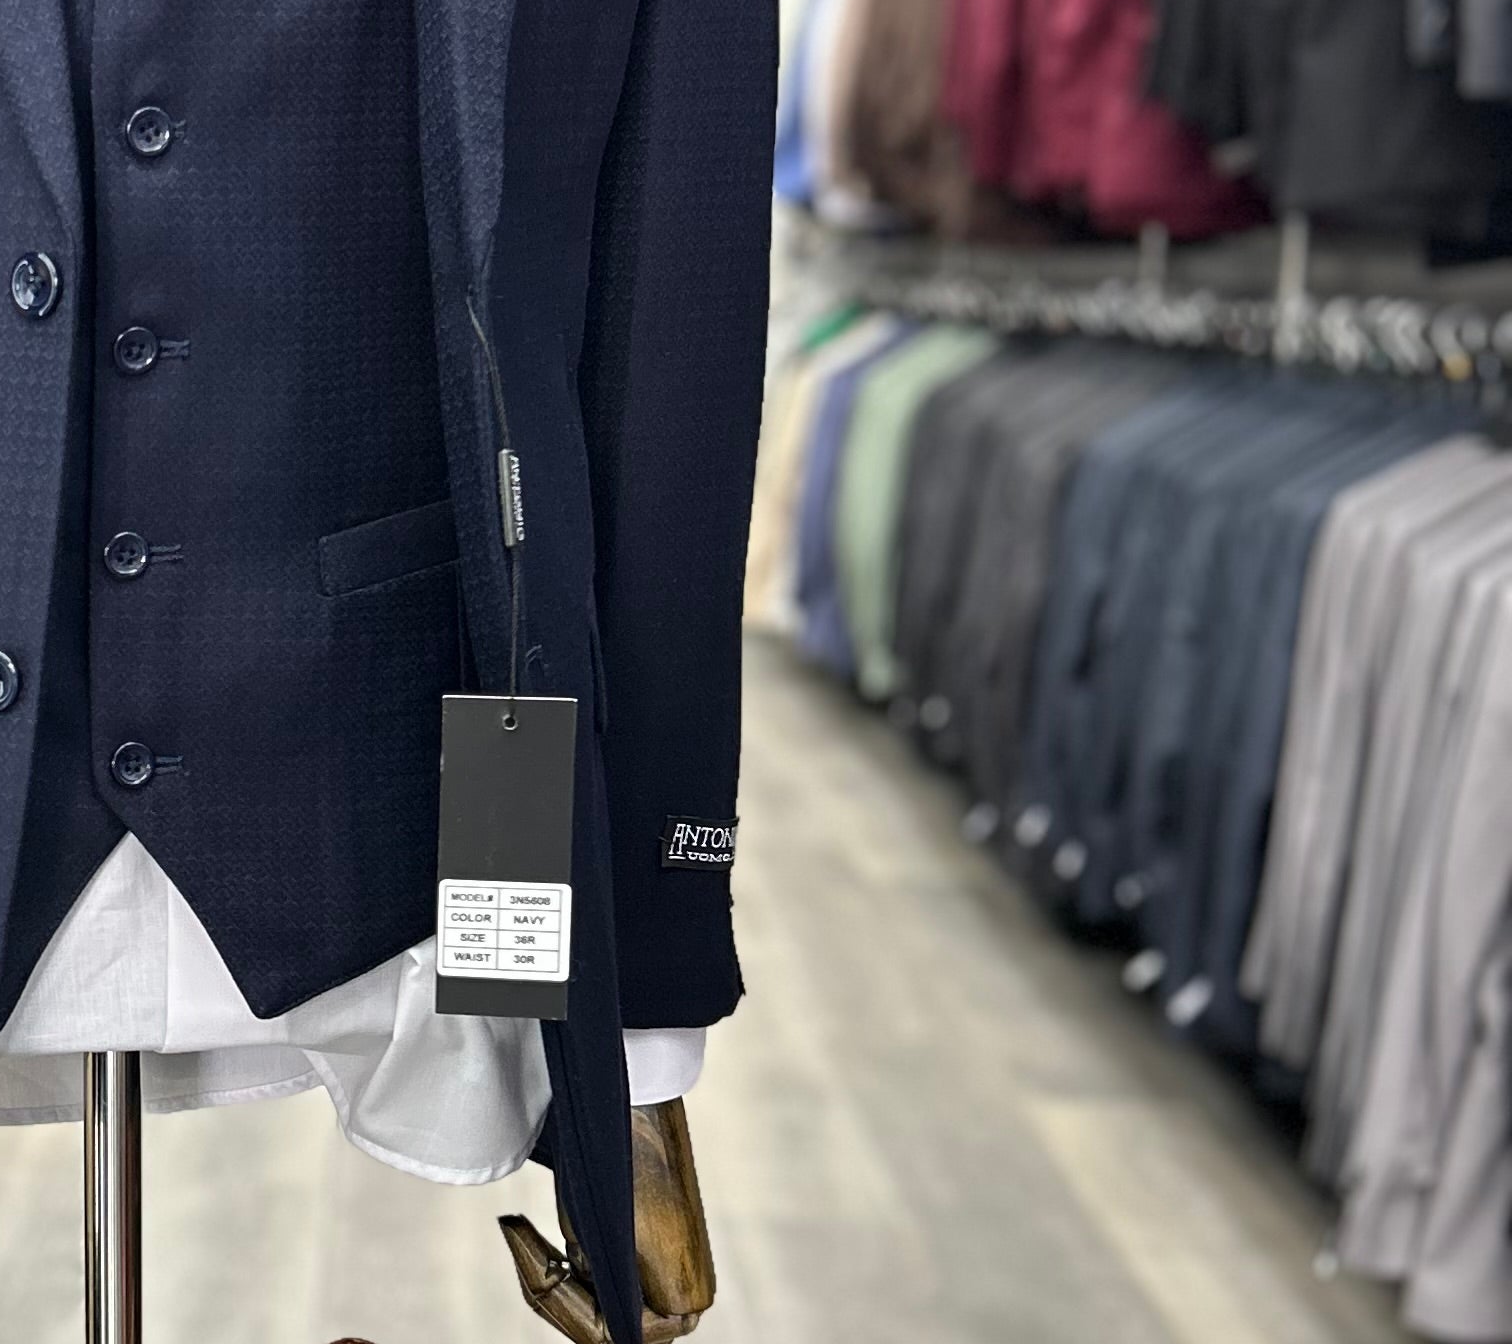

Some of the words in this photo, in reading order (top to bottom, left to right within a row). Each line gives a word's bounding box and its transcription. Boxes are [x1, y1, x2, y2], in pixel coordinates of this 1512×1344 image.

[451, 913, 492, 923] COLOR
[513, 916, 546, 925] NAVY
[460, 933, 486, 942] SIZE
[454, 952, 491, 963] WAIST
[513, 955, 535, 964] 30R
